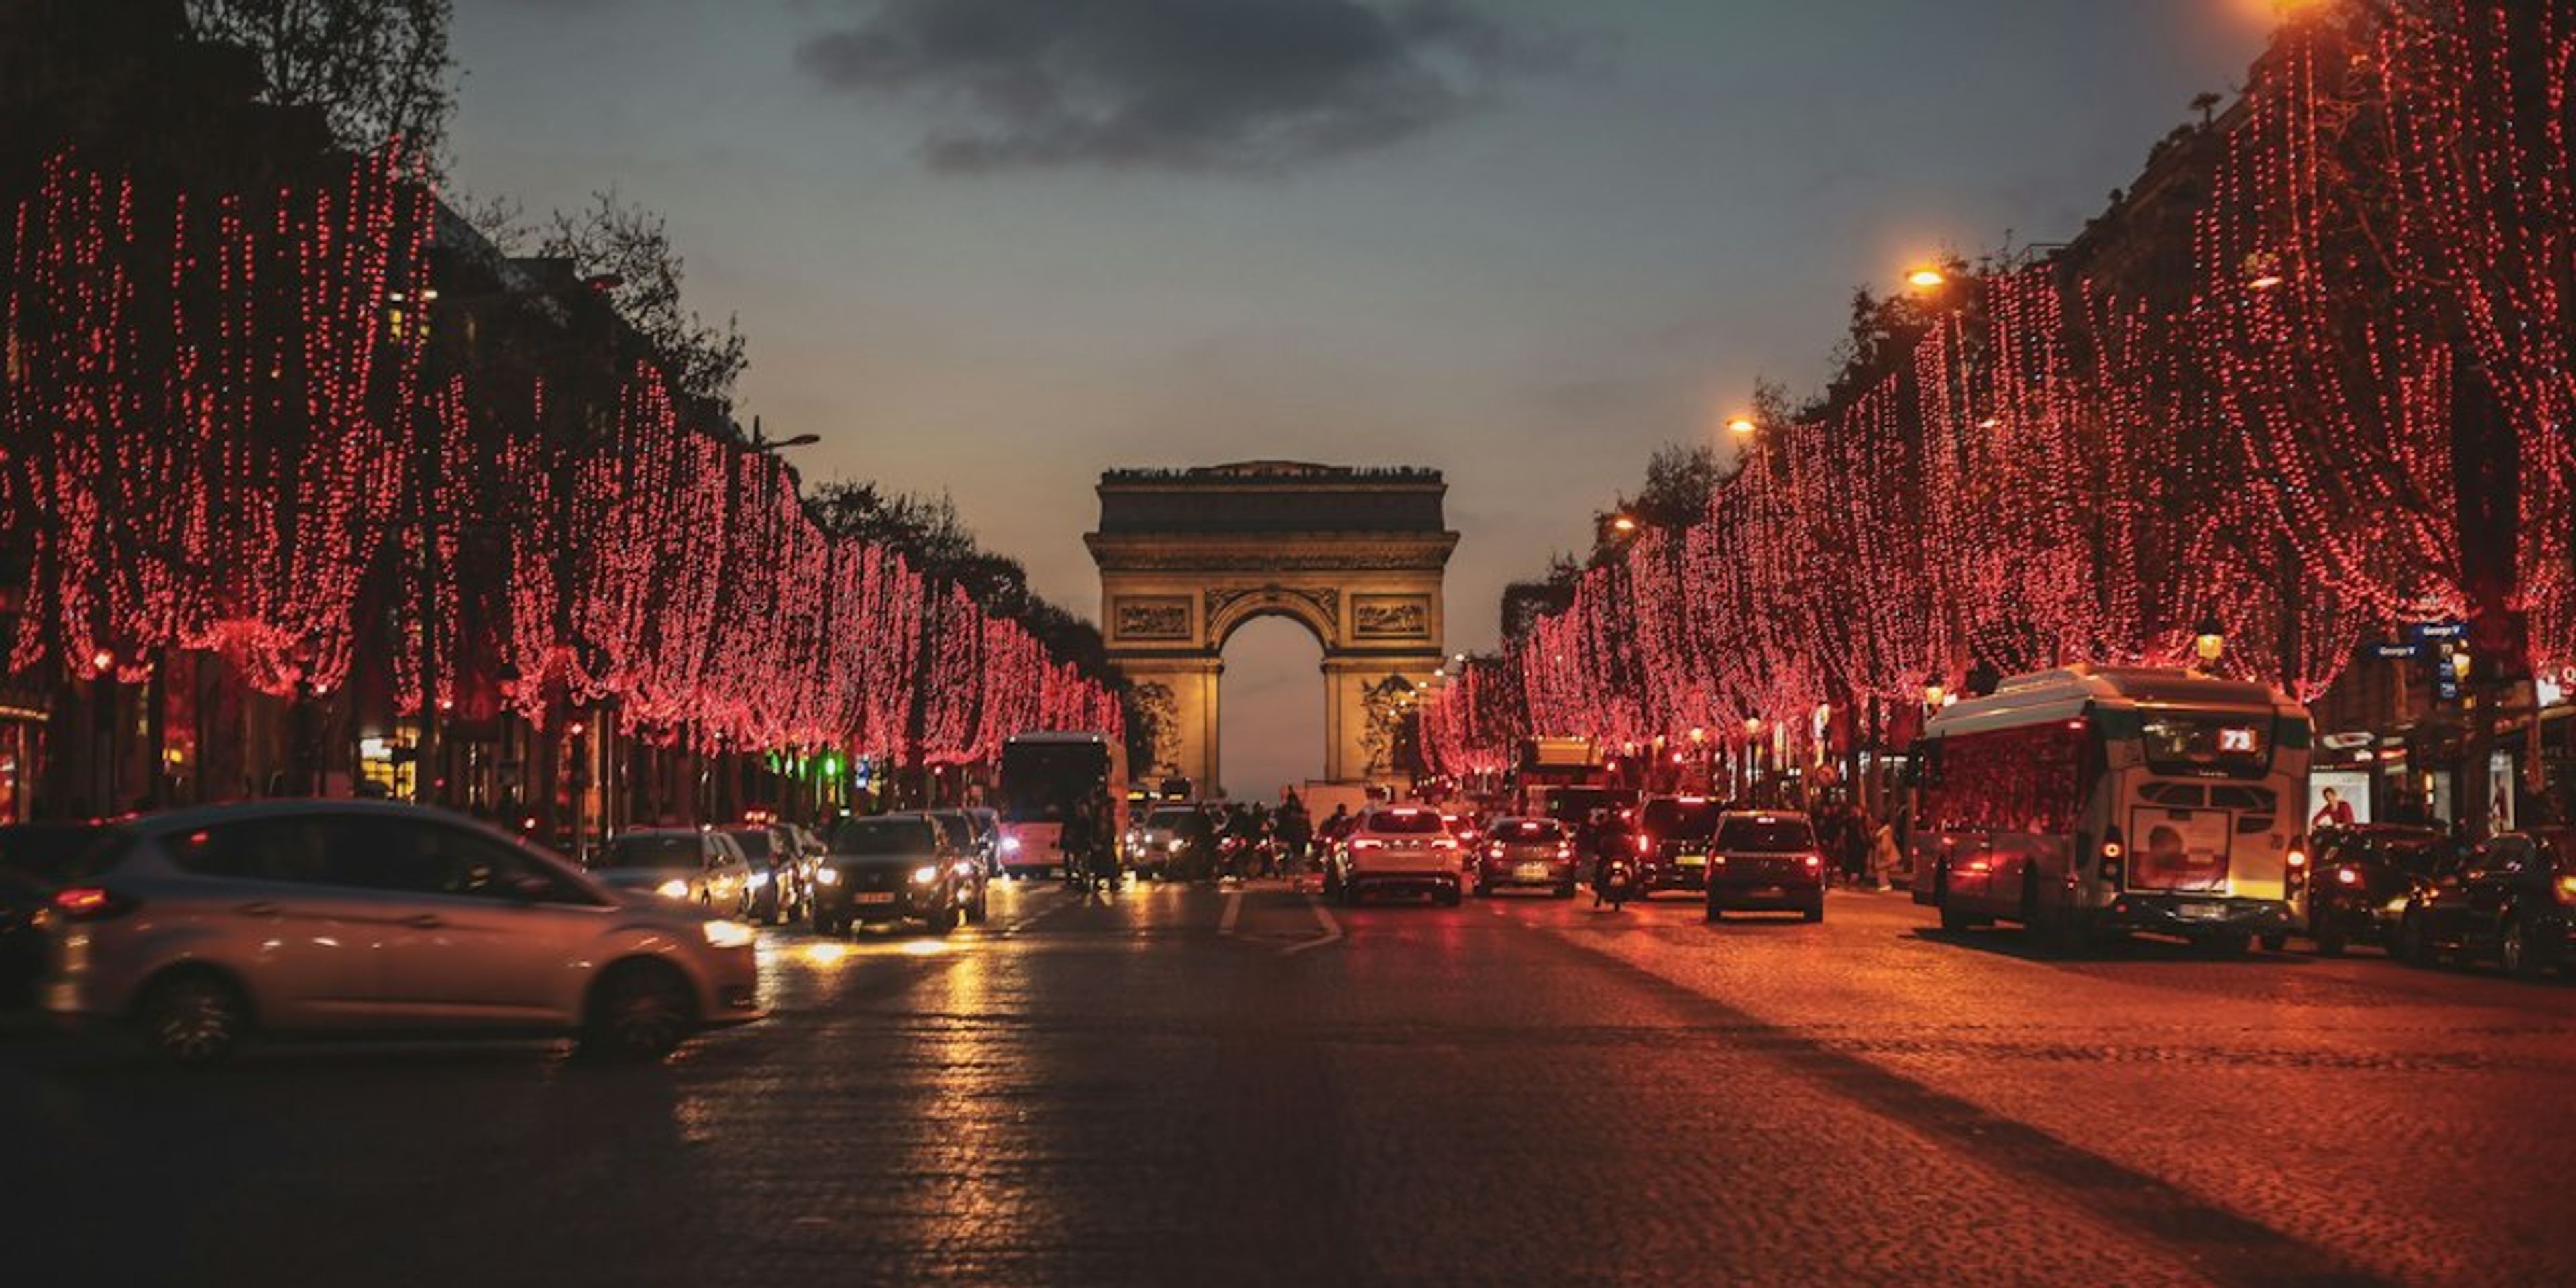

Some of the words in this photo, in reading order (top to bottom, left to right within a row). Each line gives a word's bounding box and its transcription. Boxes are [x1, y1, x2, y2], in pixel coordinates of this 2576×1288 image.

[2423, 625, 2451, 636] George
[2452, 625, 2460, 633] V
[2379, 647, 2407, 656] George
[2222, 729, 2250, 750] 73
